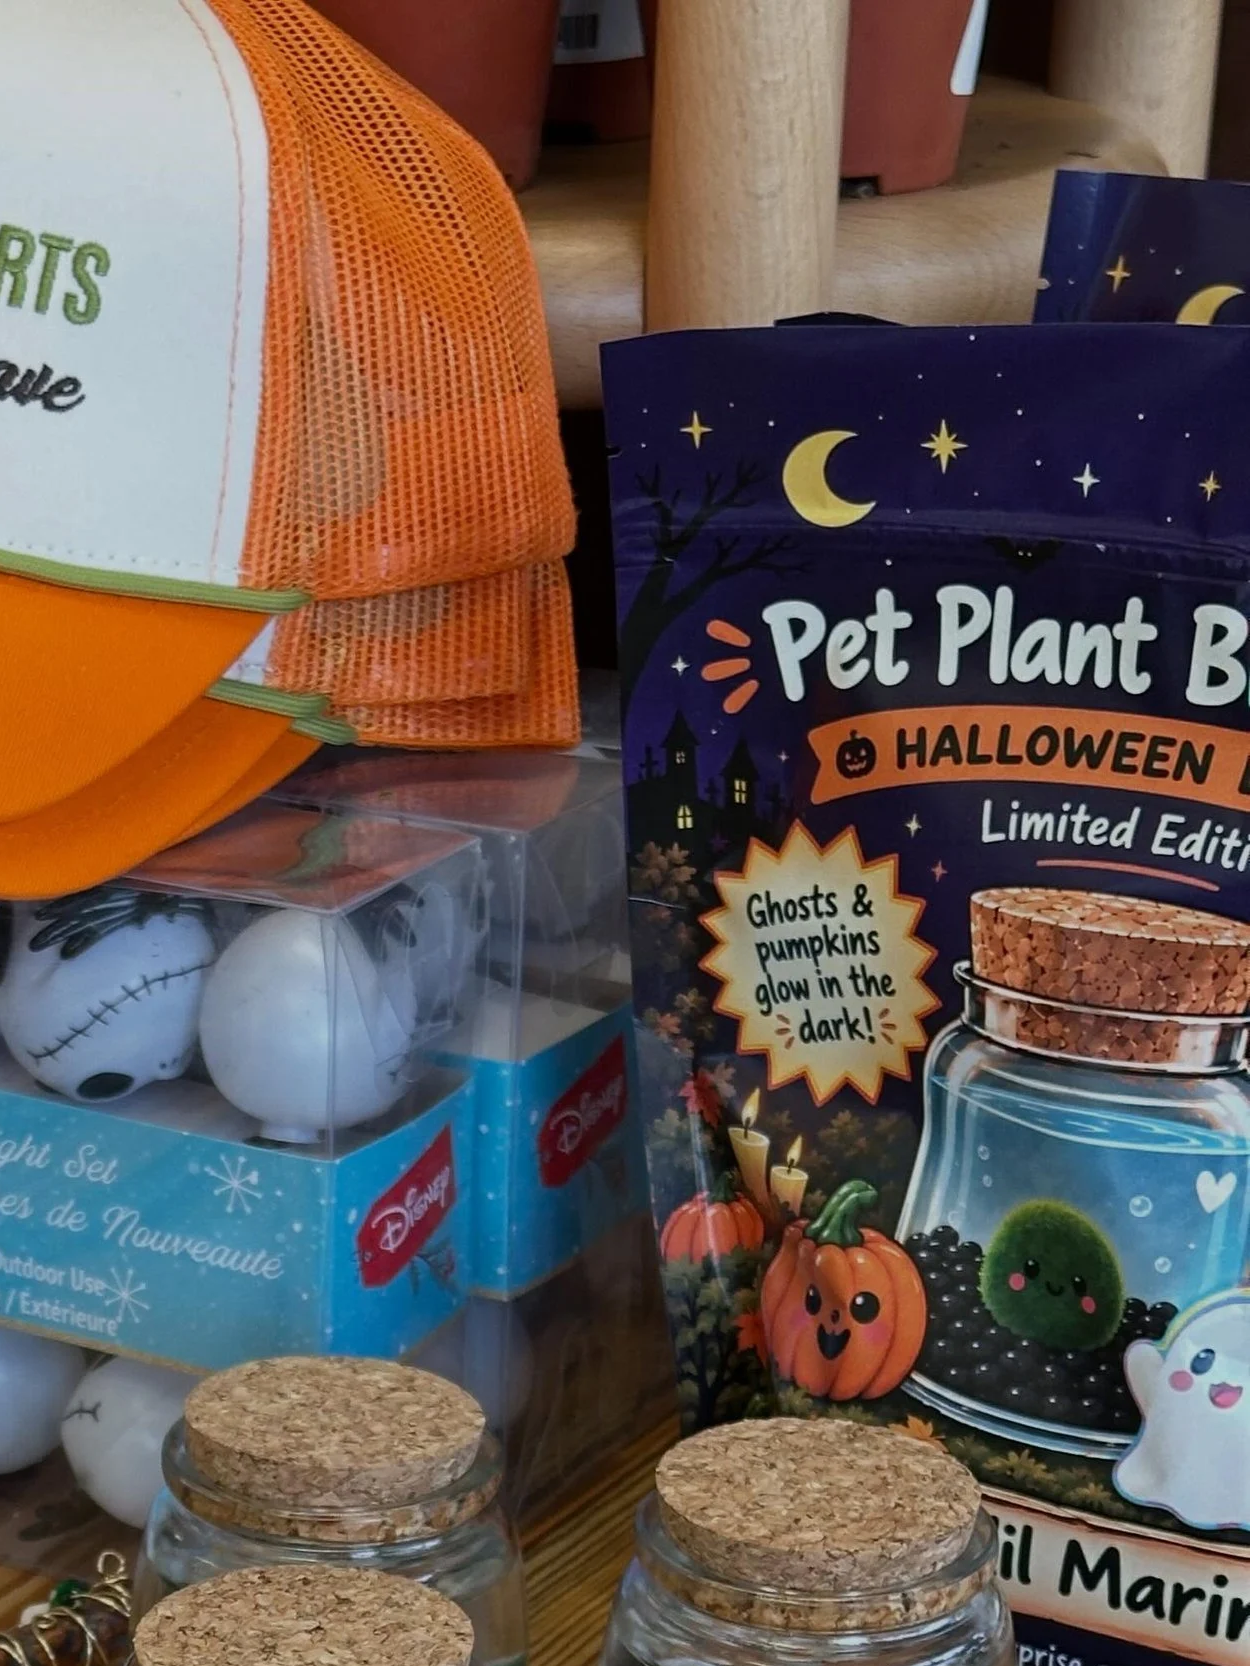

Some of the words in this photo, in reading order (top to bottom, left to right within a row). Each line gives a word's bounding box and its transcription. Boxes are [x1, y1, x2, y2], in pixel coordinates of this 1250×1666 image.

[762, 587, 913, 701] Pet
[936, 584, 1158, 696] Plant
[896, 723, 1216, 785] HALLOWEEN
[980, 798, 1141, 850] Limited
[746, 884, 838, 929] Ghosts
[852, 883, 874, 917] &
[755, 923, 881, 972] pumpkins
[755, 972, 811, 1016] glow
[815, 969, 844, 999] in
[848, 962, 896, 998] the
[799, 1006, 876, 1044] dark!
[63, 1144, 119, 1185] Set
[46, 1199, 88, 1232] de
[70, 1267, 105, 1297] Use
